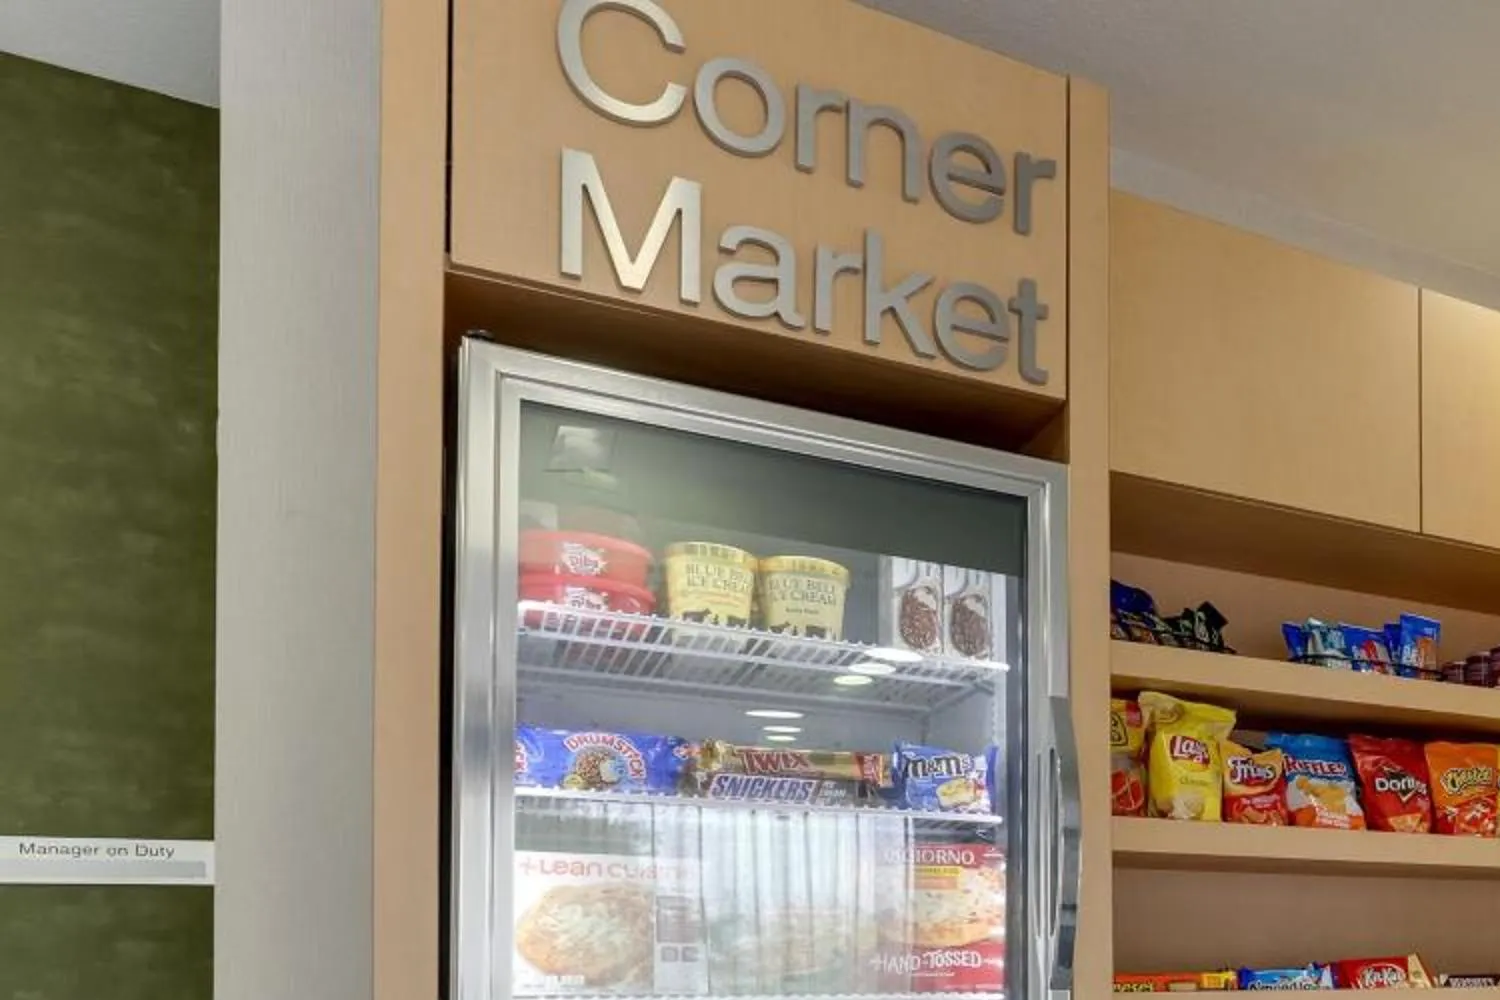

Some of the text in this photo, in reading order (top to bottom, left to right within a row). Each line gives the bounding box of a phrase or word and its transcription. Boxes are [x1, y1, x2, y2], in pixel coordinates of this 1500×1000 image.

[556, 0, 1057, 236] Corner
[560, 147, 1049, 385] Market
[563, 732, 648, 780] DRUMSTICK
[741, 750, 811, 775] TWIX
[1284, 755, 1349, 777] RUFFLES
[1227, 756, 1276, 783] Fritos
[711, 774, 814, 800] SNICKERS
[1375, 775, 1427, 796] Doritos
[19, 843, 175, 858] Manager on Duty
